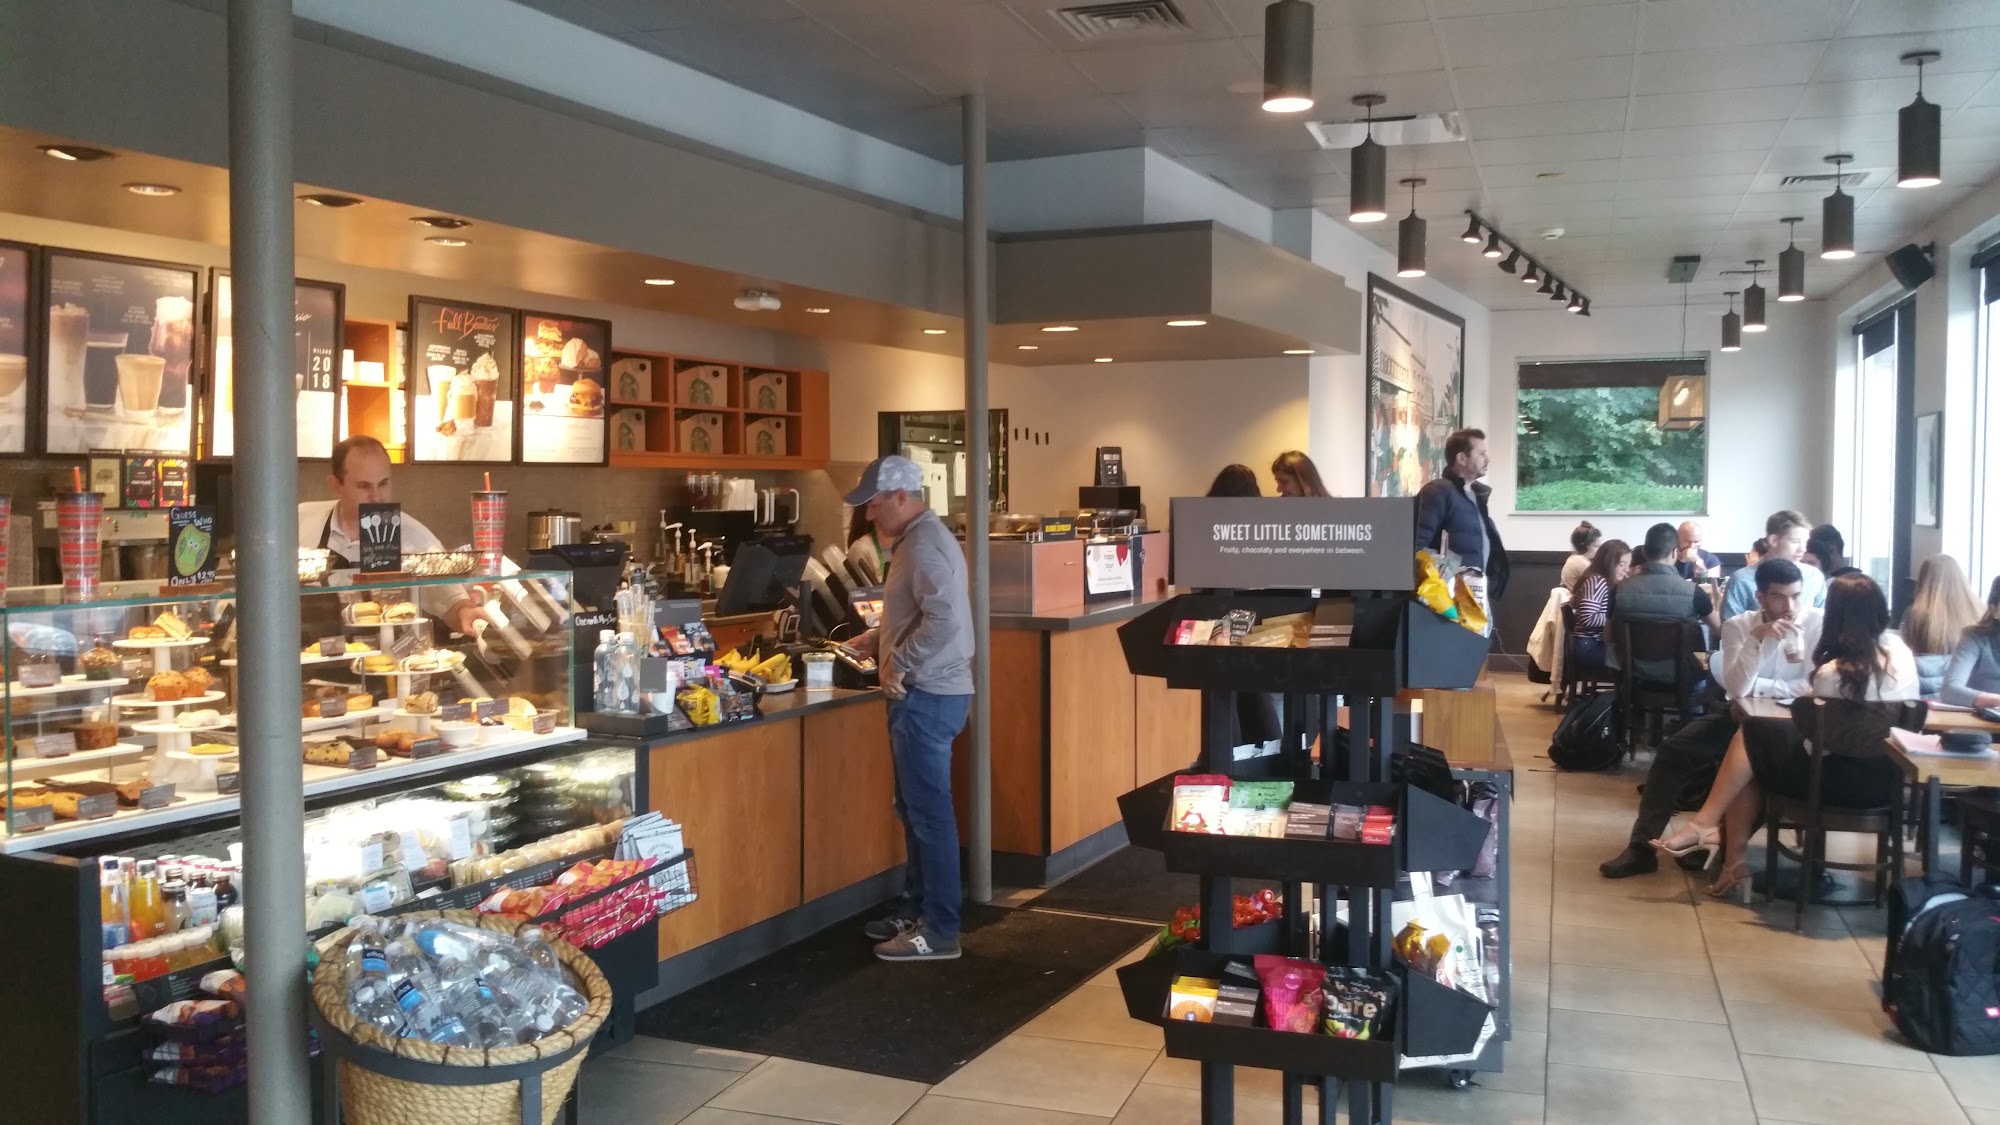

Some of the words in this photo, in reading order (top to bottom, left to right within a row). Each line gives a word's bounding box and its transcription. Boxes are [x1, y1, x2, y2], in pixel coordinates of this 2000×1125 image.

[312, 355, 331, 372] 20
[312, 372, 331, 389] 18
[1212, 523, 1251, 541] SWEET
[1253, 523, 1292, 541] LITTLE
[1294, 523, 1373, 542] SOMETHINGS
[1219, 545, 1241, 555] Fruity,
[1241, 546, 1273, 555] chocolaty
[1274, 546, 1287, 554] and
[1288, 546, 1325, 555] everywhere
[1326, 546, 1334, 554] in
[1335, 546, 1366, 555] between.
